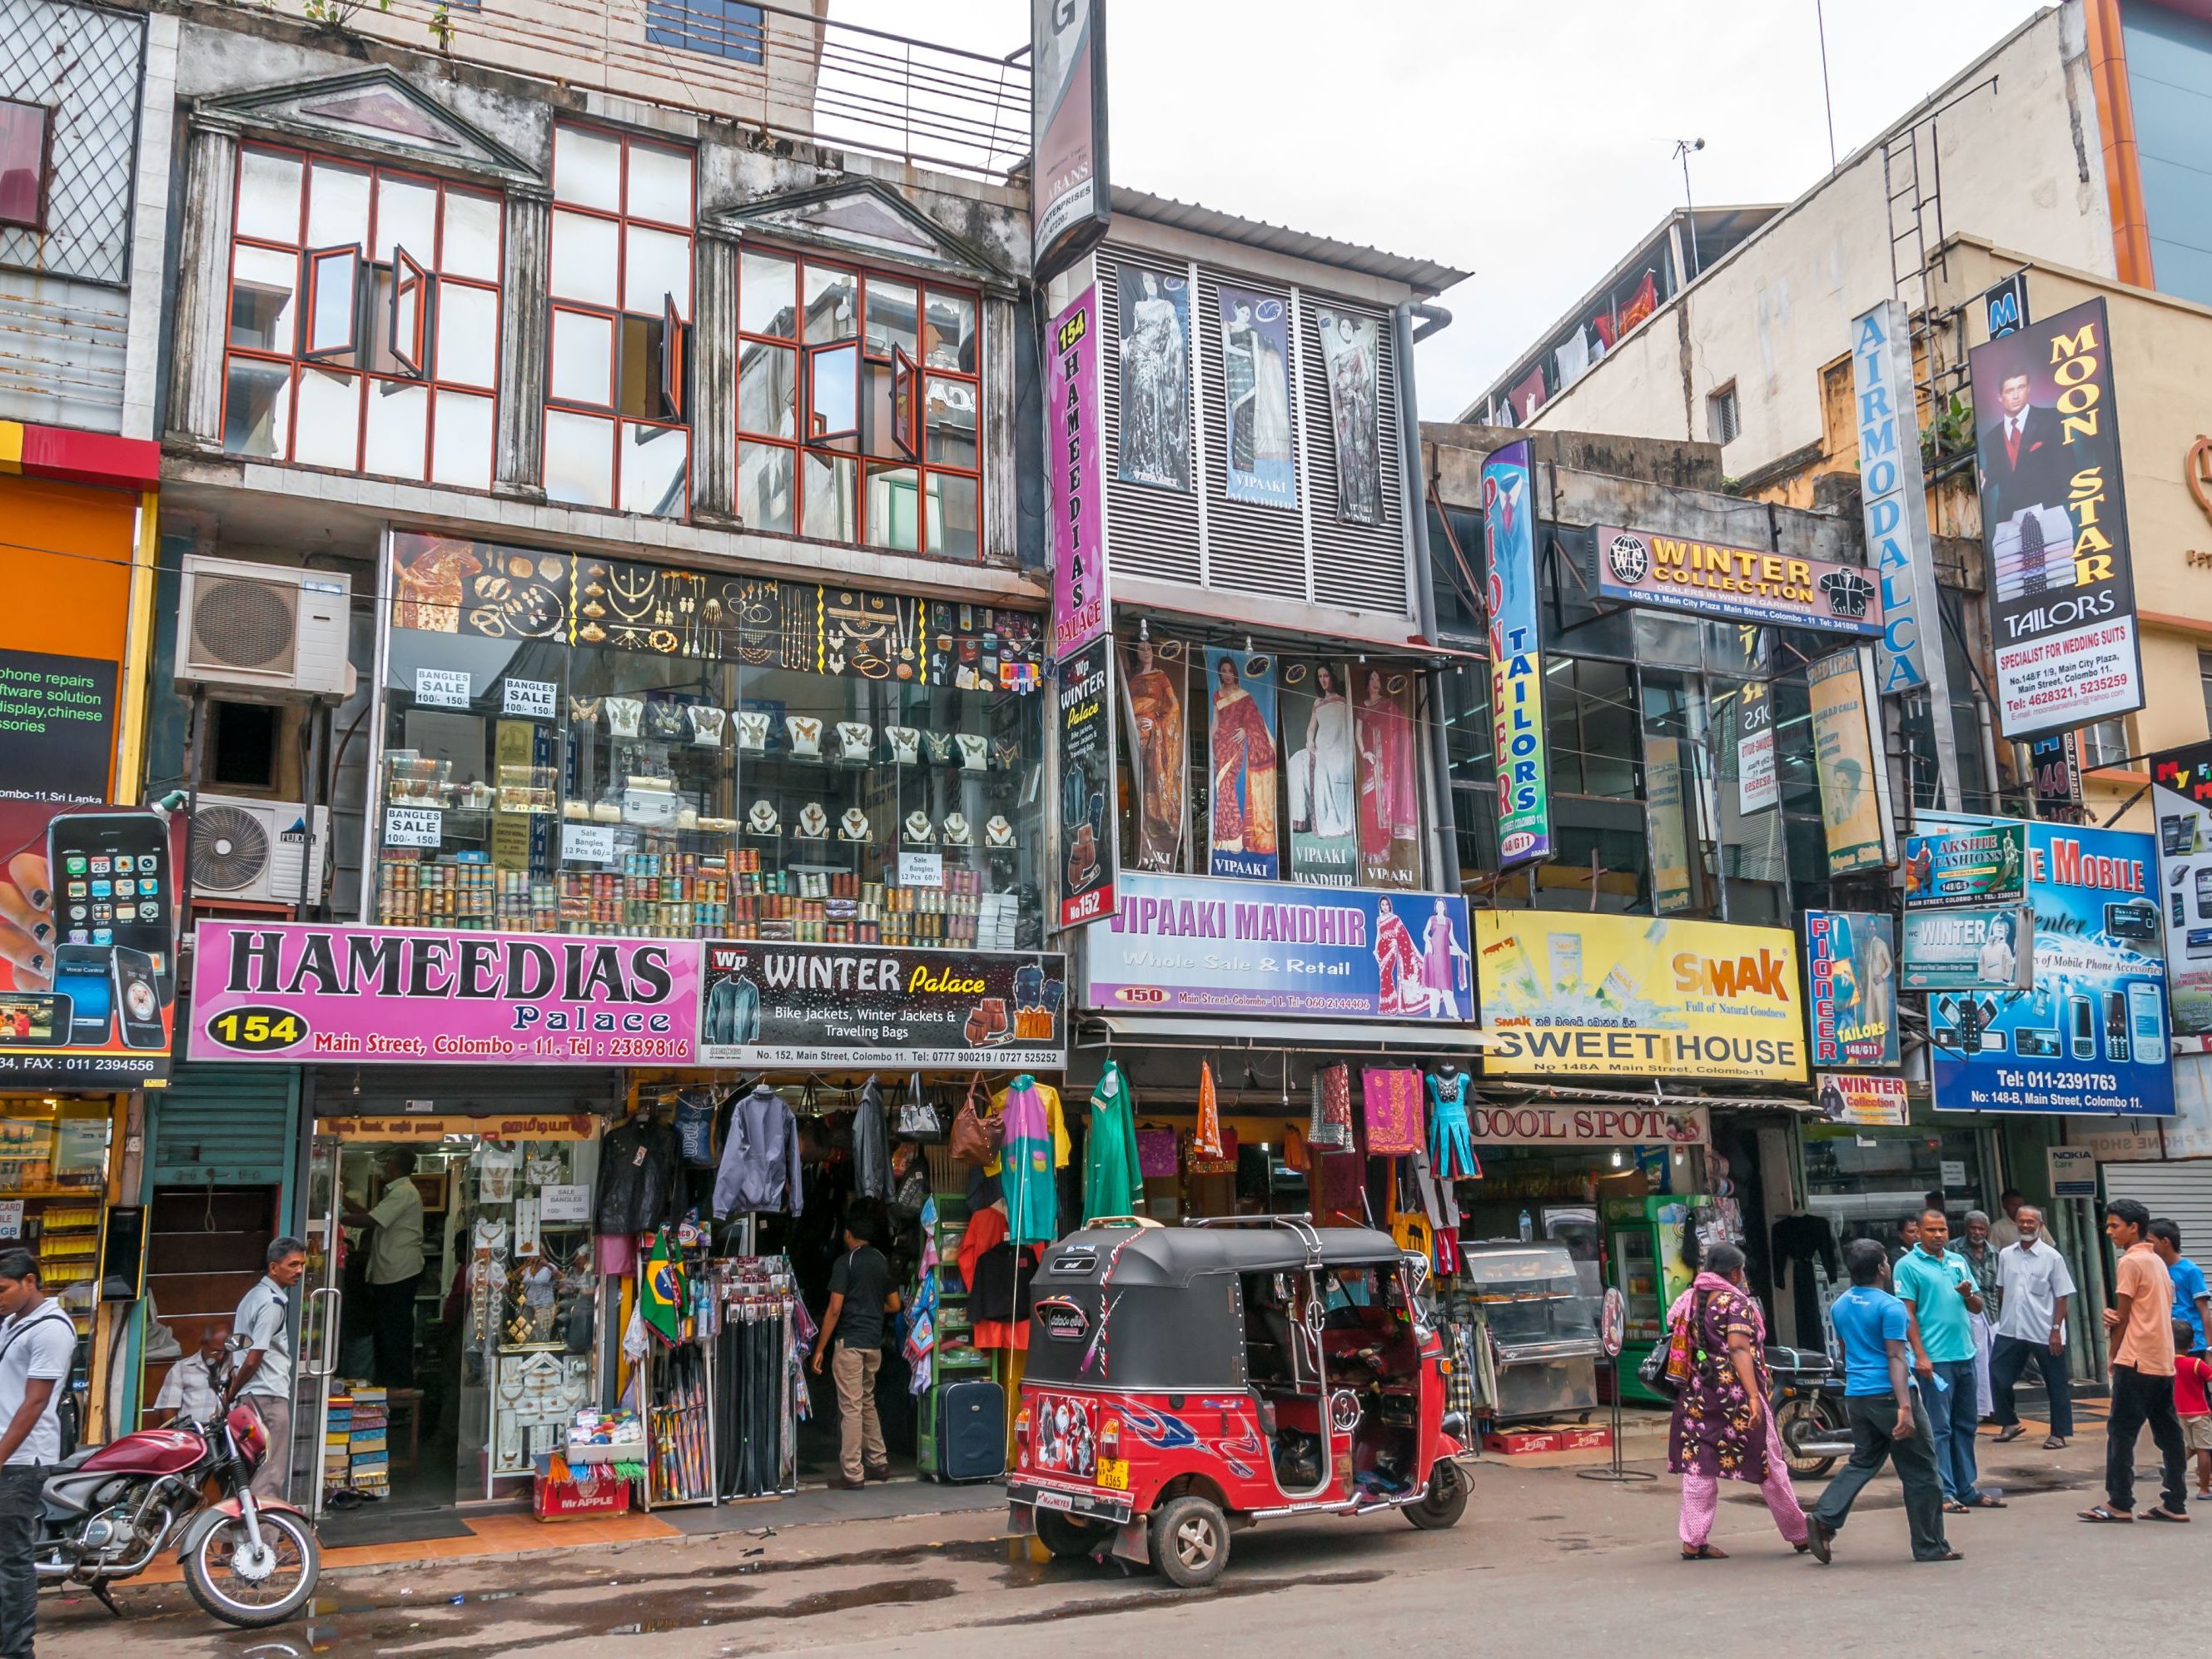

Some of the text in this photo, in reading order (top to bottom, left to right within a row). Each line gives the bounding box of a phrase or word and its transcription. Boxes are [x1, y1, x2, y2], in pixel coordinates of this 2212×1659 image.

[1060, 312, 1085, 350] 154
[2050, 323, 2100, 445] MOON
[1064, 349, 1085, 611] HAMEEDIAS
[1235, 473, 1287, 494] VIPAAKI
[2068, 466, 2115, 588] STAR
[1651, 537, 1813, 587] WINTER
[1653, 566, 1815, 604] COLLECTION
[1657, 584, 1757, 606] DEALERS WINTER
[1699, 600, 1721, 611] Plaza
[1723, 603, 1744, 615] Main
[1743, 607, 1769, 619] Street,
[1769, 610, 1802, 623] Colombo
[2003, 589, 2116, 638] TAILORS
[1056, 599, 1101, 648] PALACE
[1484, 475, 1514, 820] PIONEER
[2001, 626, 2125, 670] SPECIALIST FOR WEDDING SUITS
[2059, 663, 2077, 674] Main
[2078, 658, 2094, 670] City
[2095, 653, 2120, 666] Plaza,
[45, 674, 95, 688] repairs
[418, 670, 470, 682] BANGLES
[505, 679, 556, 693] BANGLES
[2018, 669, 2099, 694] Main Street, Colombo
[46, 689, 102, 705] solution
[420, 680, 466, 694] SALE
[509, 689, 553, 705] SALE
[1060, 669, 1106, 711] WINTER
[2006, 673, 2128, 713] Tel: 4628321, 5235259
[417, 693, 470, 707] 100/- 150/-
[505, 702, 556, 717] 100/- 150/-
[1838, 700, 1859, 713] CALLS
[1067, 702, 1100, 729] Palace
[1507, 626, 1538, 812] TAILORS
[2157, 761, 2190, 790] My
[67, 793, 102, 805] Lanka
[387, 809, 441, 821] BANGLES
[391, 819, 437, 833] SALE
[580, 829, 598, 837] Sale
[386, 833, 440, 846] 100/- 150/-
[574, 837, 604, 848] Bangles
[1295, 847, 1348, 865] VIPAAKI
[1933, 849, 2003, 868] FASHIONS
[2050, 837, 2146, 895] MOBILE
[1214, 857, 1267, 877] VIPAAKI
[1367, 867, 1414, 882] VIPAAKI
[1070, 891, 1101, 921] No 152
[1110, 895, 1367, 948] VIPAAKI MANDHIR
[1921, 919, 1988, 946] WINTER
[225, 930, 674, 1004] HAMEEDIAS
[714, 948, 749, 971] Wp
[1123, 951, 1350, 976] Whole Sale & Retail
[2053, 956, 2164, 977] Mobile Phone Accessories
[764, 953, 987, 995] WINTER Palace
[1123, 988, 1164, 1003] 150
[1811, 917, 1837, 1060] PIONEER
[1178, 991, 1370, 1010] Main 2144406
[1685, 1000, 1787, 1019] Full Natural Goodness
[511, 1005, 672, 1034] Palace
[775, 1006, 957, 1023] Bike jackets, Winter Jackets &
[216, 1014, 298, 1044] 154
[313, 1031, 361, 1054] Main
[366, 1032, 428, 1056] Street,
[433, 1036, 514, 1056] Colombo
[567, 1036, 593, 1057] Tel
[608, 1038, 689, 1059] 2389816
[825, 1024, 909, 1041] Traveling Bags
[1837, 1021, 1887, 1044] TAILORS
[775, 1051, 1058, 1064] 152, Main Street, Colombo Tel: 0777 900219 0727 525252
[1494, 1031, 1797, 1066] SWEET HOUSE
[23, 1058, 155, 1071] FAX 011 2394556
[1561, 1063, 1765, 1076] 148A Main Street, Colombo-11
[1837, 1076, 1905, 1096] WINTER
[1996, 1070, 2118, 1092] Tel: 011-2391763
[1846, 1095, 1896, 1109] Collection
[1971, 1090, 2129, 1109] No: 148-B, Main Street, Colombo
[1469, 1109, 1666, 1140] COOL SPOT
[2052, 1151, 2092, 1160] NOKIA
[2055, 1160, 2073, 1169] Care
[557, 1188, 576, 1196] SALE
[1105, 1475, 1121, 1488] 8365
[580, 1497, 614, 1508] APPLE
